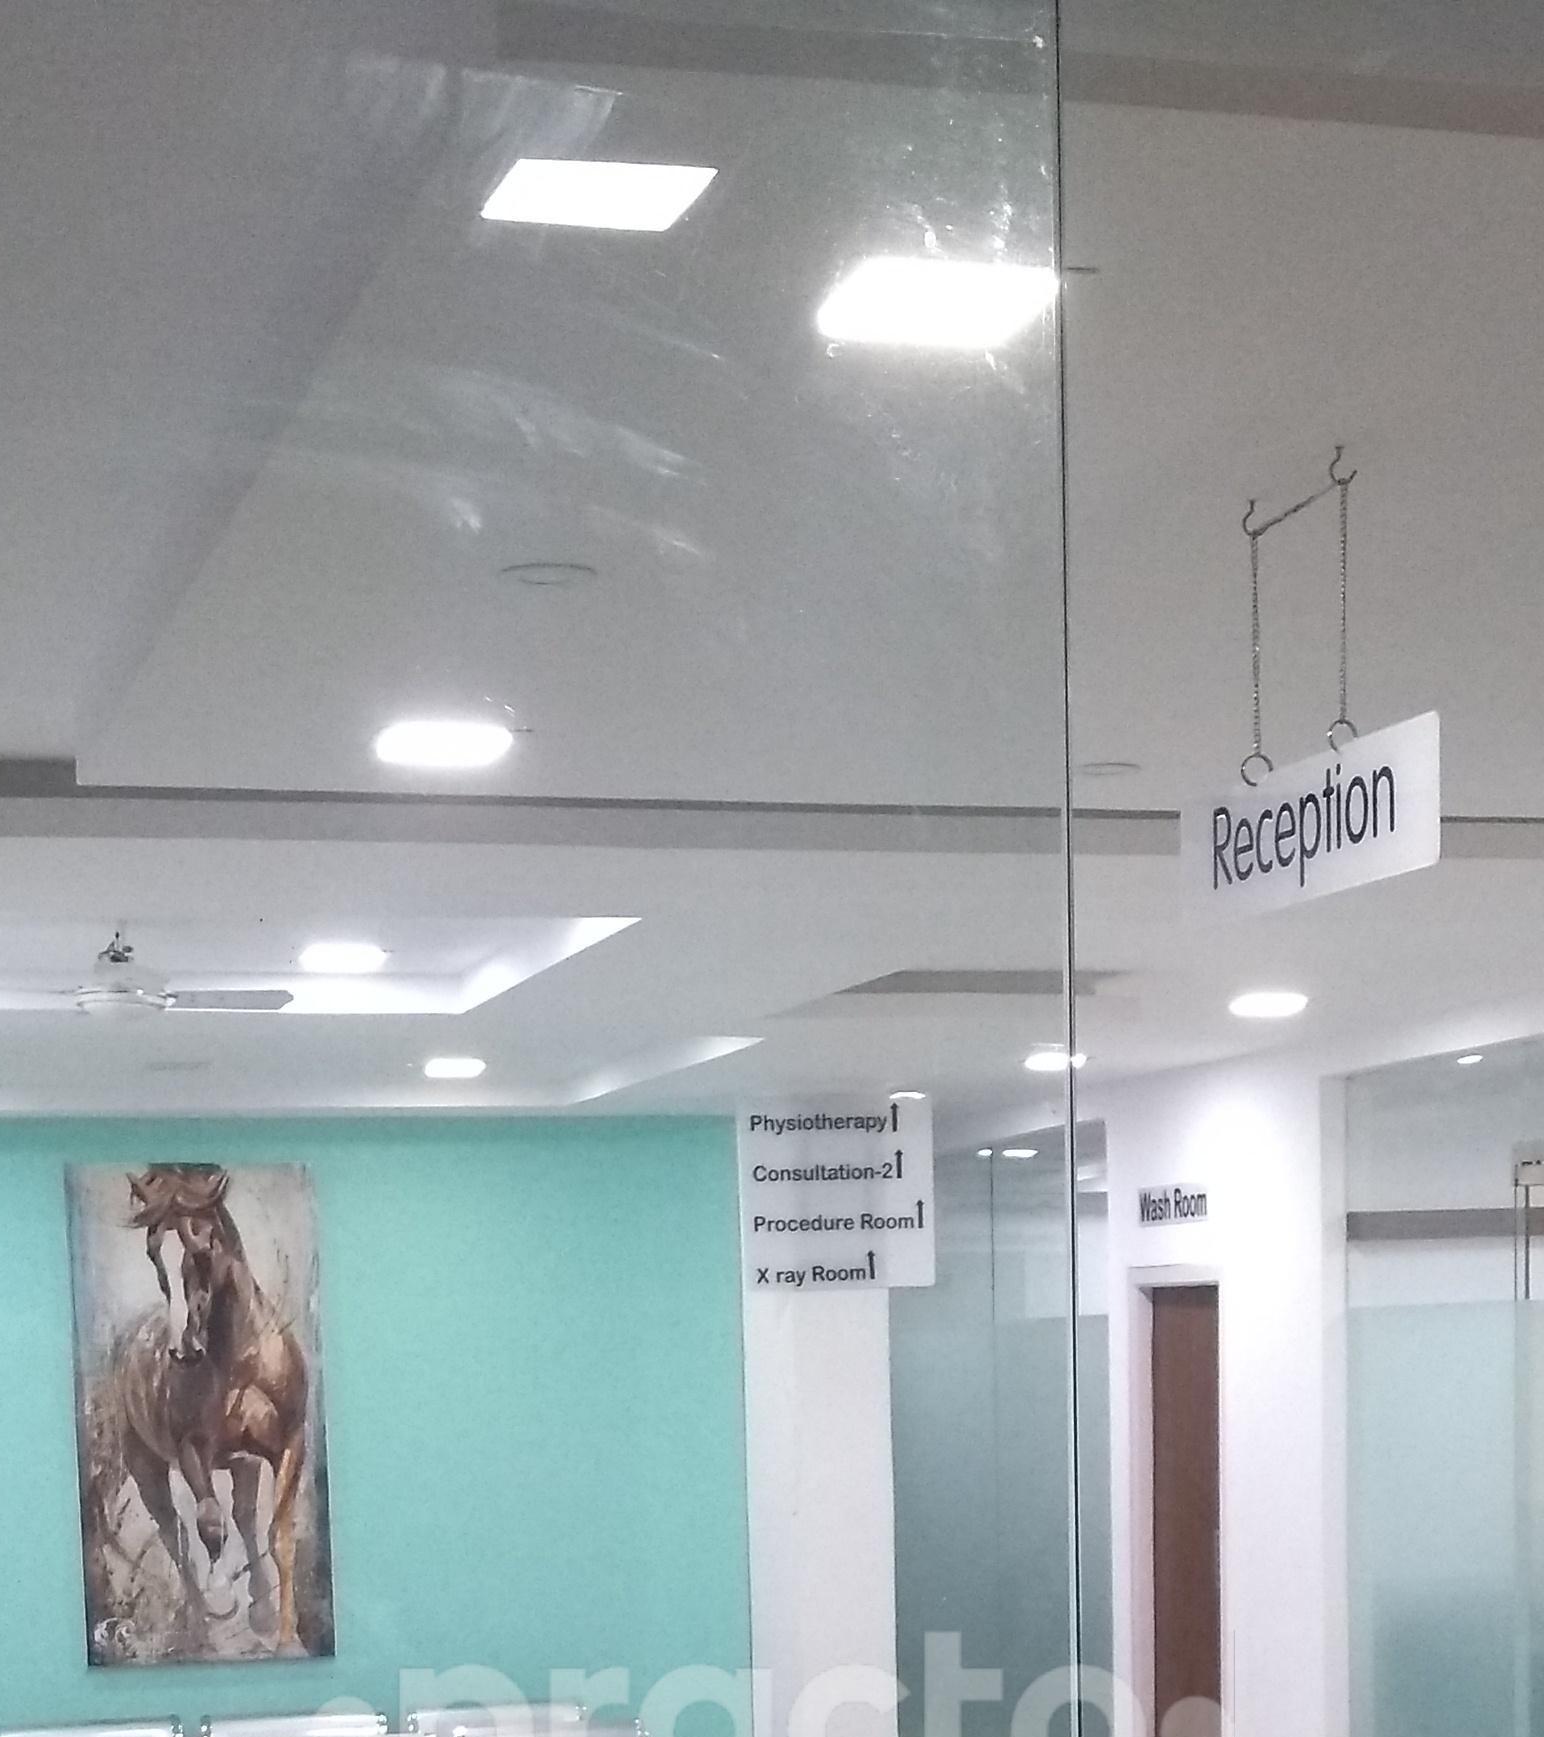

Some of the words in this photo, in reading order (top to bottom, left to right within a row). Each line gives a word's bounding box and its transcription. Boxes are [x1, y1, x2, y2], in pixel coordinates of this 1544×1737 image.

[1212, 763, 1395, 890] Reception
[749, 1113, 887, 1135] Physiotherapy
[752, 1162, 893, 1182] Consultation-2
[1139, 1189, 1171, 1222] Wash
[1174, 1187, 1207, 1219] Room
[753, 1214, 855, 1232] Procedure
[860, 1213, 915, 1230] Room
[757, 1267, 769, 1284] X
[776, 1270, 806, 1287] ray
[812, 1265, 866, 1282] Room
